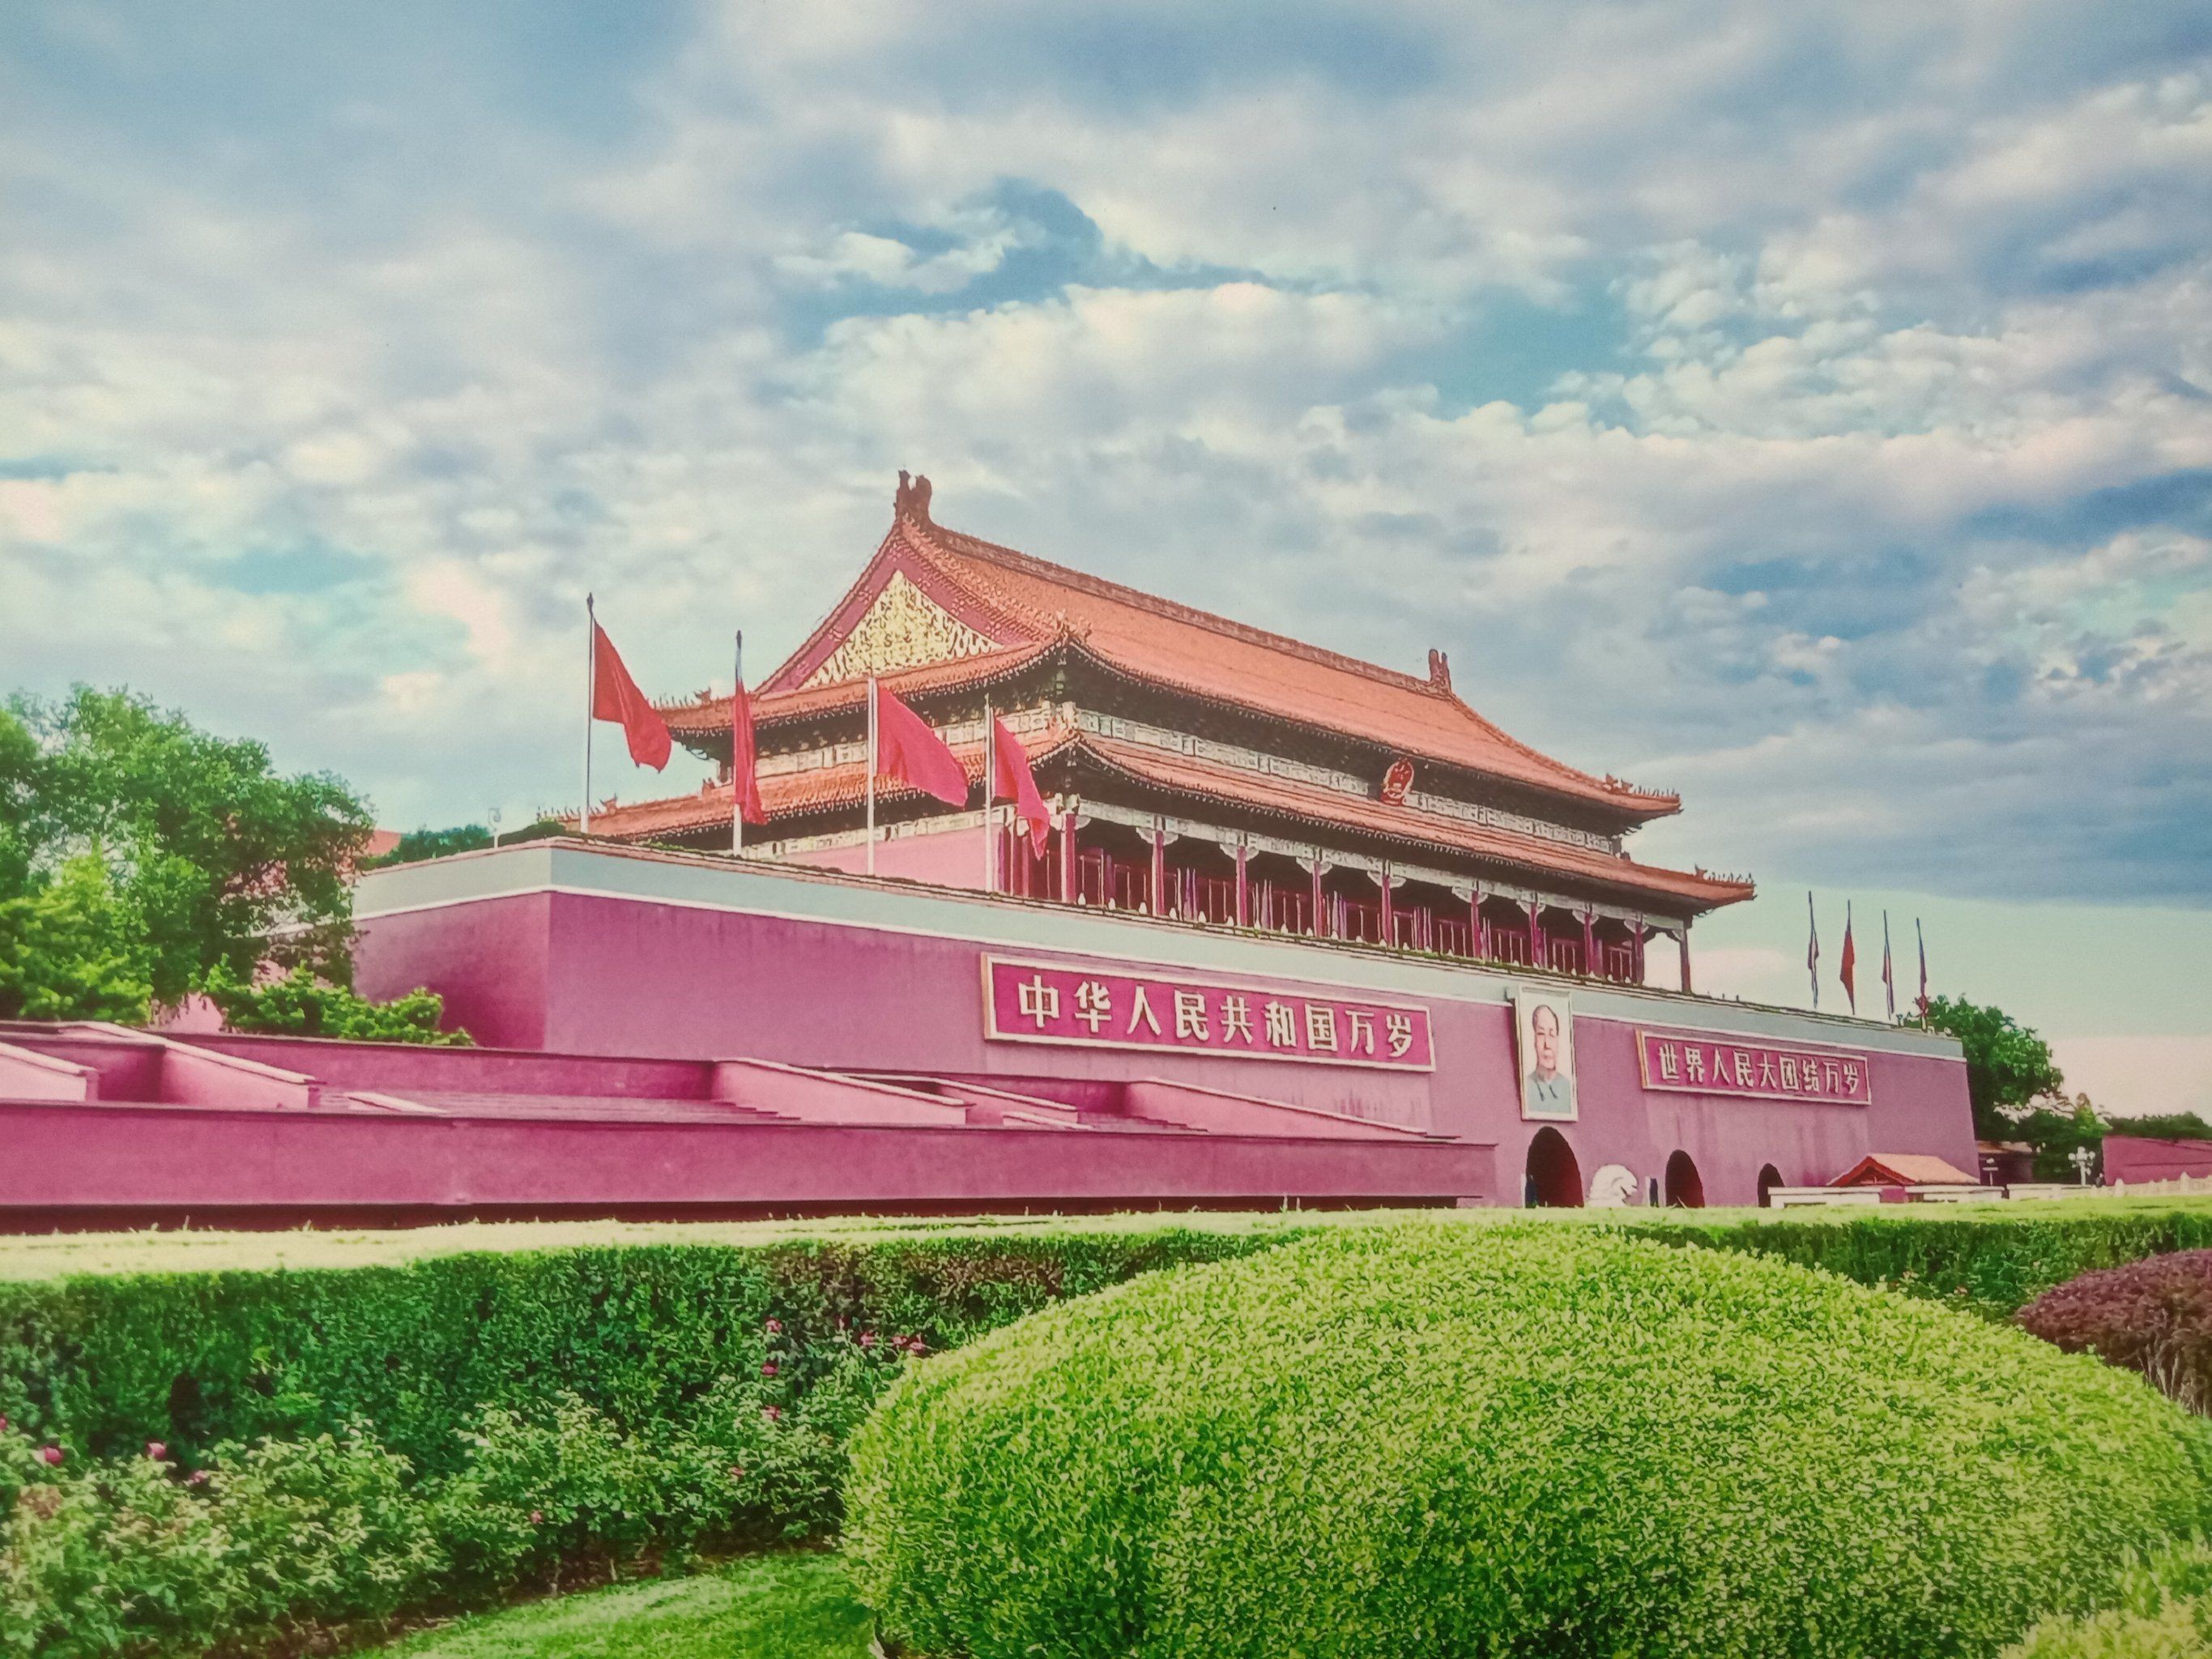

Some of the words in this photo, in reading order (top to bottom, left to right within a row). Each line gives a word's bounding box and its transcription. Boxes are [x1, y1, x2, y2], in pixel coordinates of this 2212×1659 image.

[1018, 975, 1413, 1058] 中华人民共和国万岁
[1659, 1043, 1860, 1094] 世界人民大团结万岁
